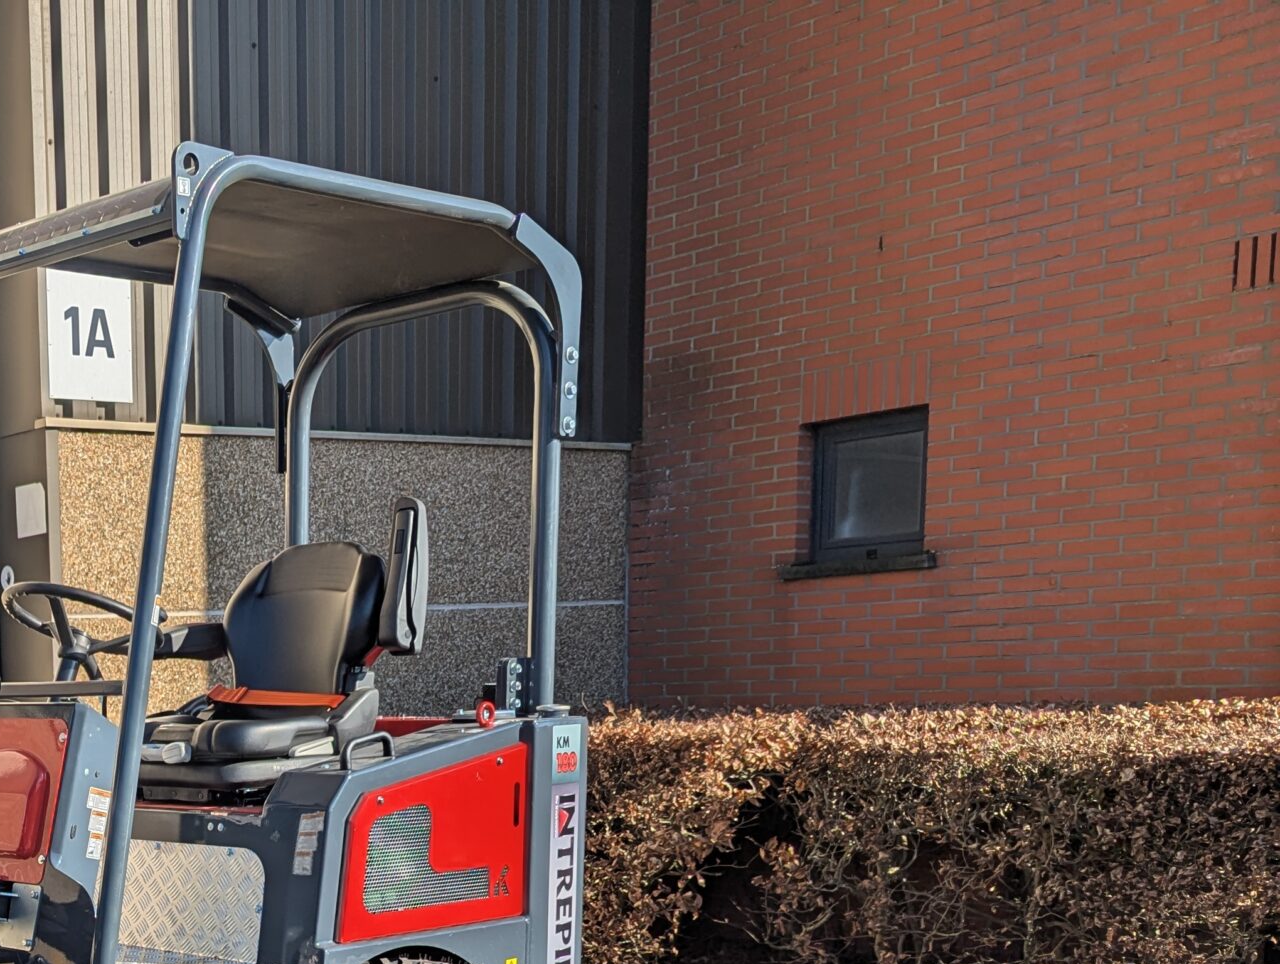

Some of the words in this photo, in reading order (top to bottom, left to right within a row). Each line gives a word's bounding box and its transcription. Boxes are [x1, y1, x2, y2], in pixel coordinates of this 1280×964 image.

[63, 305, 116, 359] 1A
[556, 735, 570, 749] KM
[555, 751, 578, 774] 180
